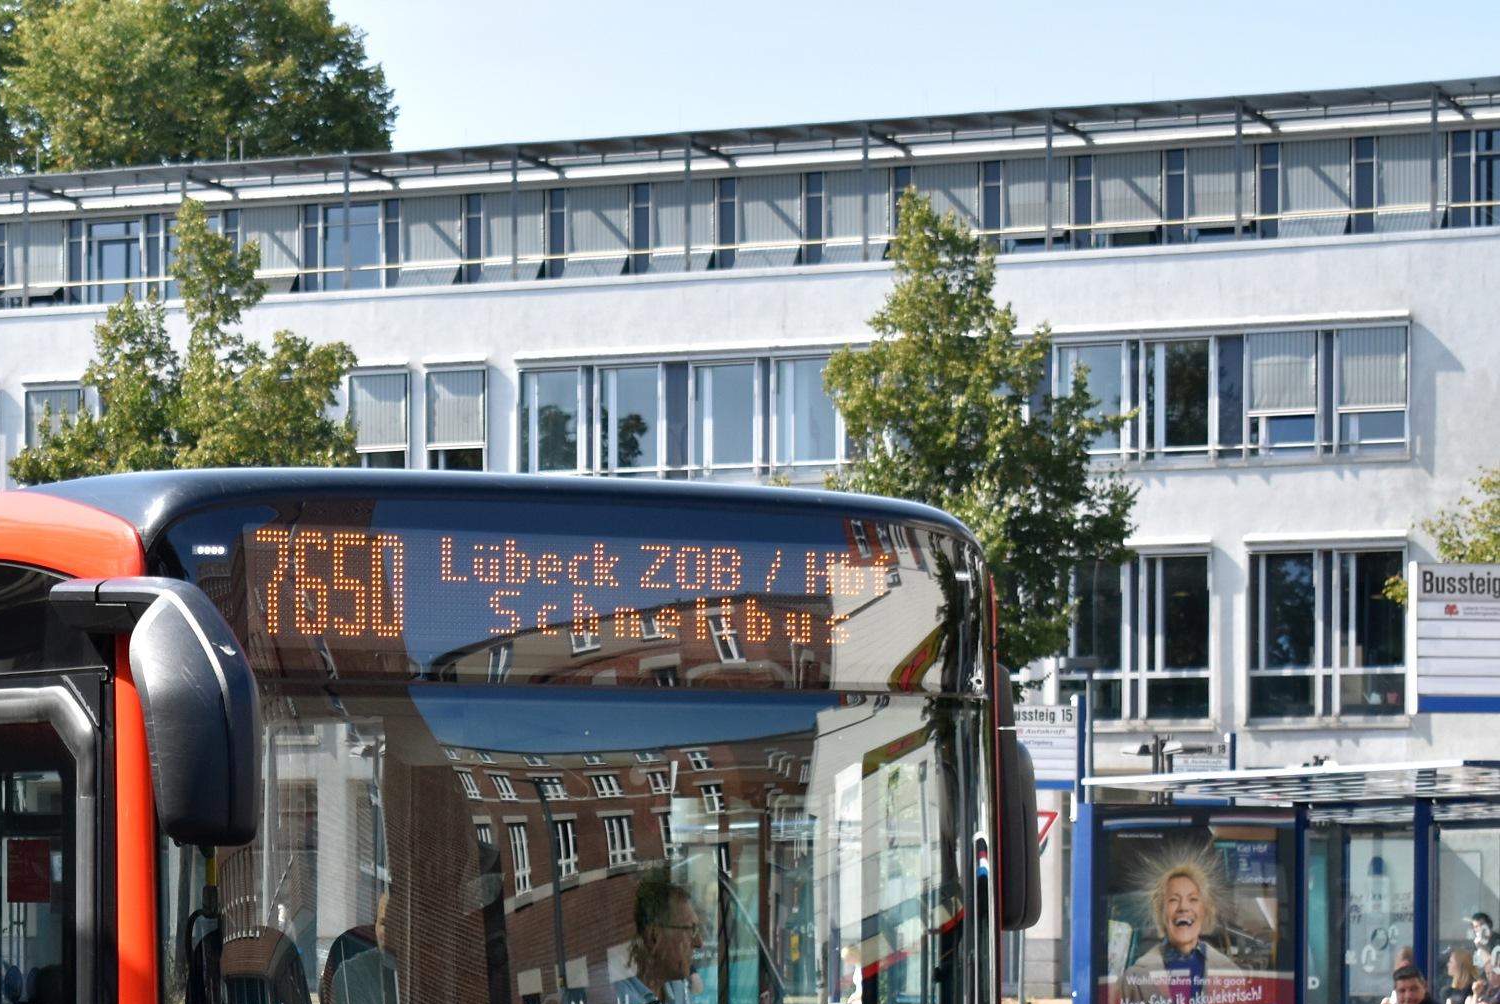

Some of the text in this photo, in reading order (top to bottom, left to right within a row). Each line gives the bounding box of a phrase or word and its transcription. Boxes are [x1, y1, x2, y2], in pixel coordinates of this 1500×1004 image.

[254, 529, 404, 636] 7650
[440, 536, 894, 597] Lübeck ZOB / Hbf
[1422, 571, 1500, 599] Bussteig
[489, 590, 851, 645] Schnellbus
[1013, 708, 1073, 724] ussteig 15
